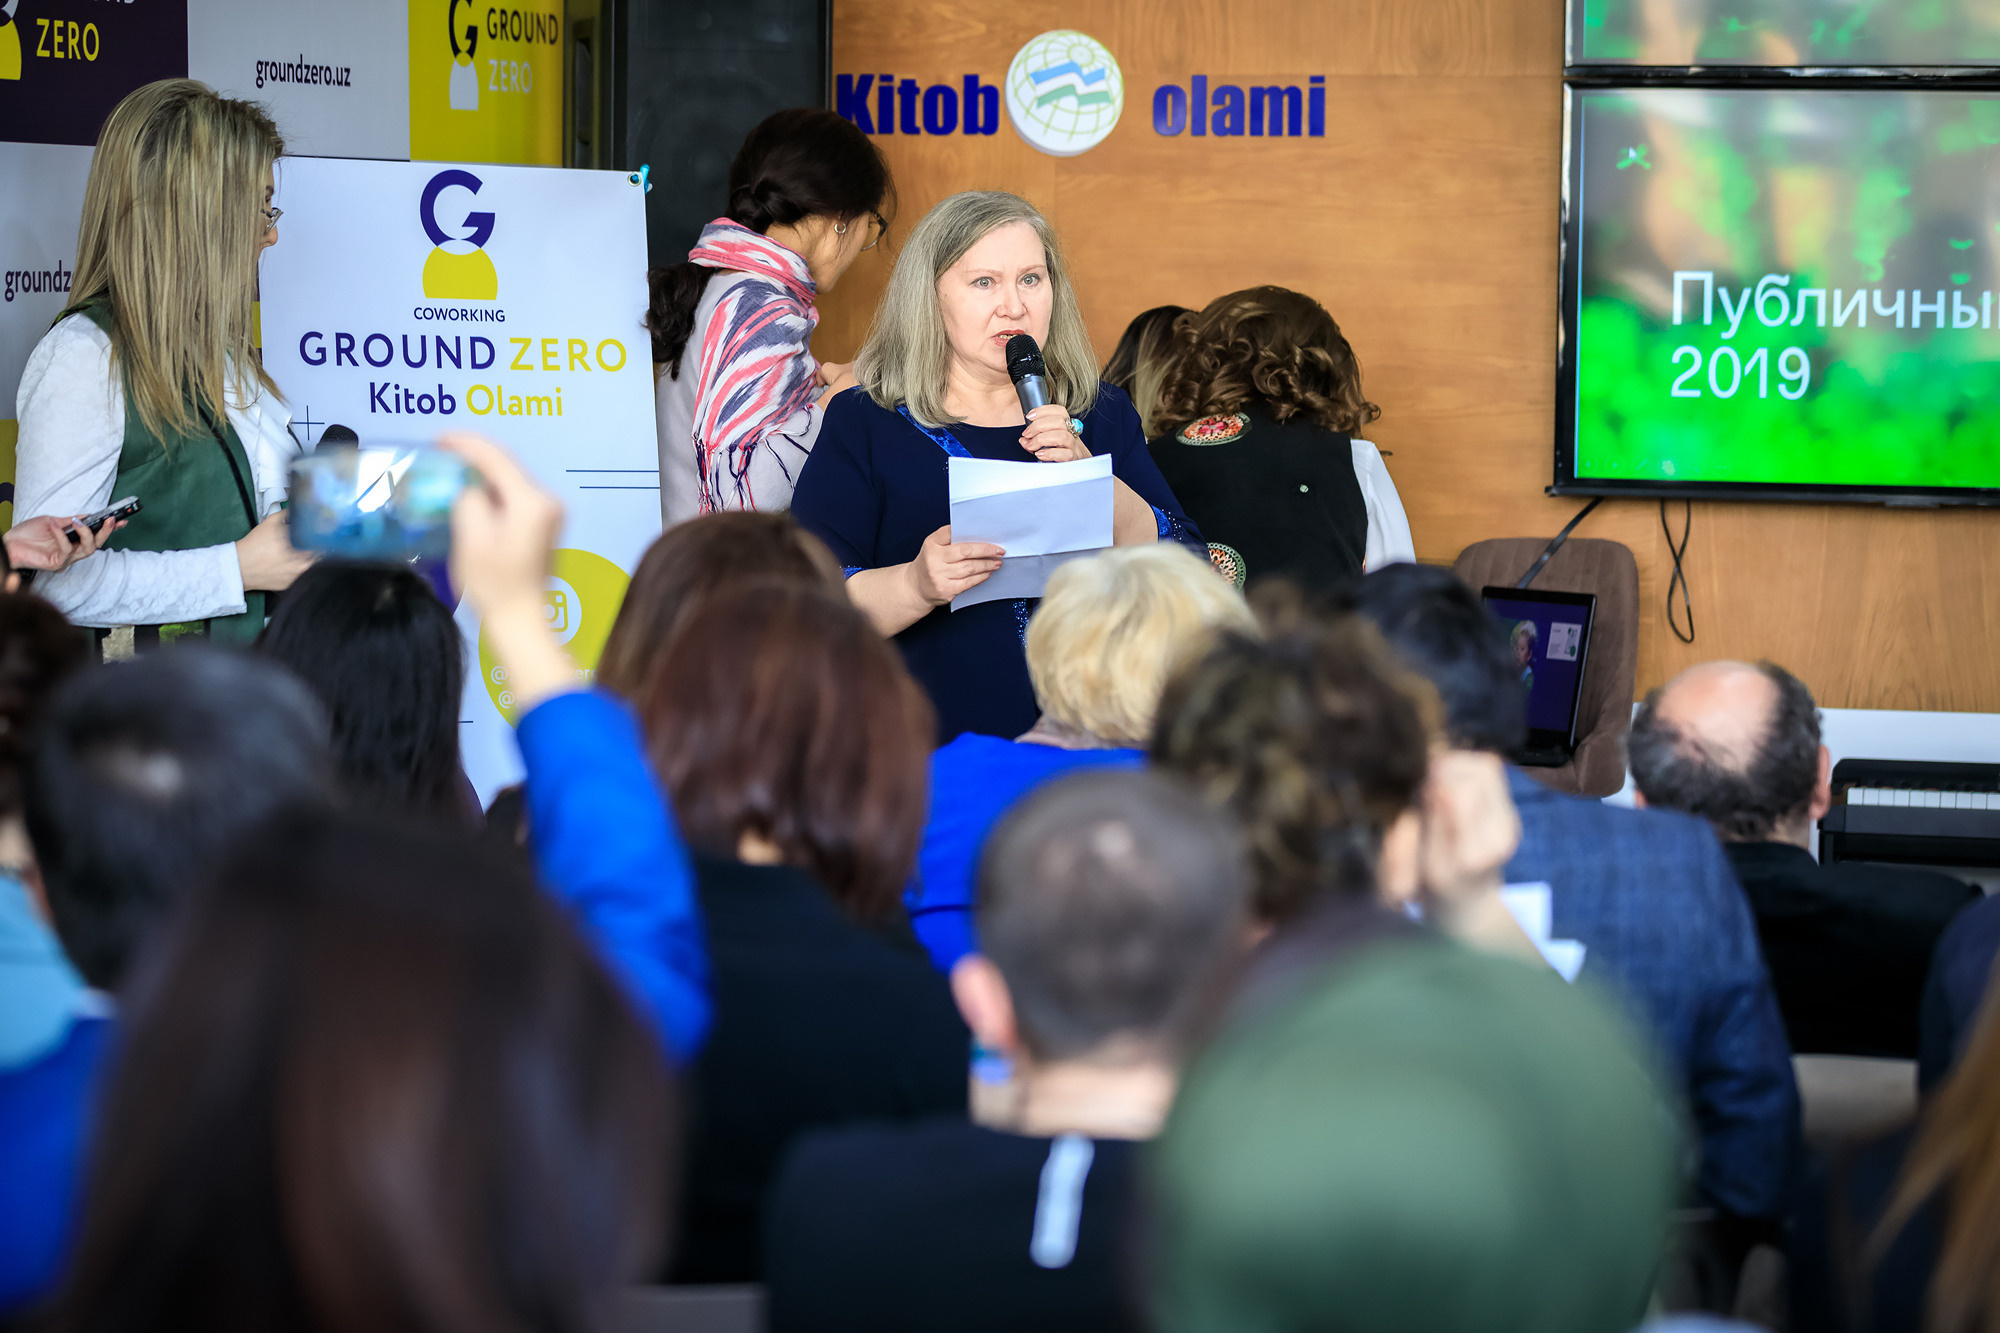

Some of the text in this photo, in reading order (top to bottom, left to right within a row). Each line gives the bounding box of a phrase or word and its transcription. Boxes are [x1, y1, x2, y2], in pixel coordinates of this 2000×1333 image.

[36, 18, 100, 61] ZERO
[487, 7, 559, 45] GROUND
[256, 53, 351, 89] groundzero.uz
[488, 58, 532, 94] ZERO
[837, 74, 1325, 137] Kitob olami
[413, 306, 506, 323] COWORKING
[1672, 271, 2000, 339] Публичны
[299, 331, 627, 373] GROUND ZERO
[1671, 345, 1811, 401] 2019
[369, 382, 563, 417] Kitob Olami
